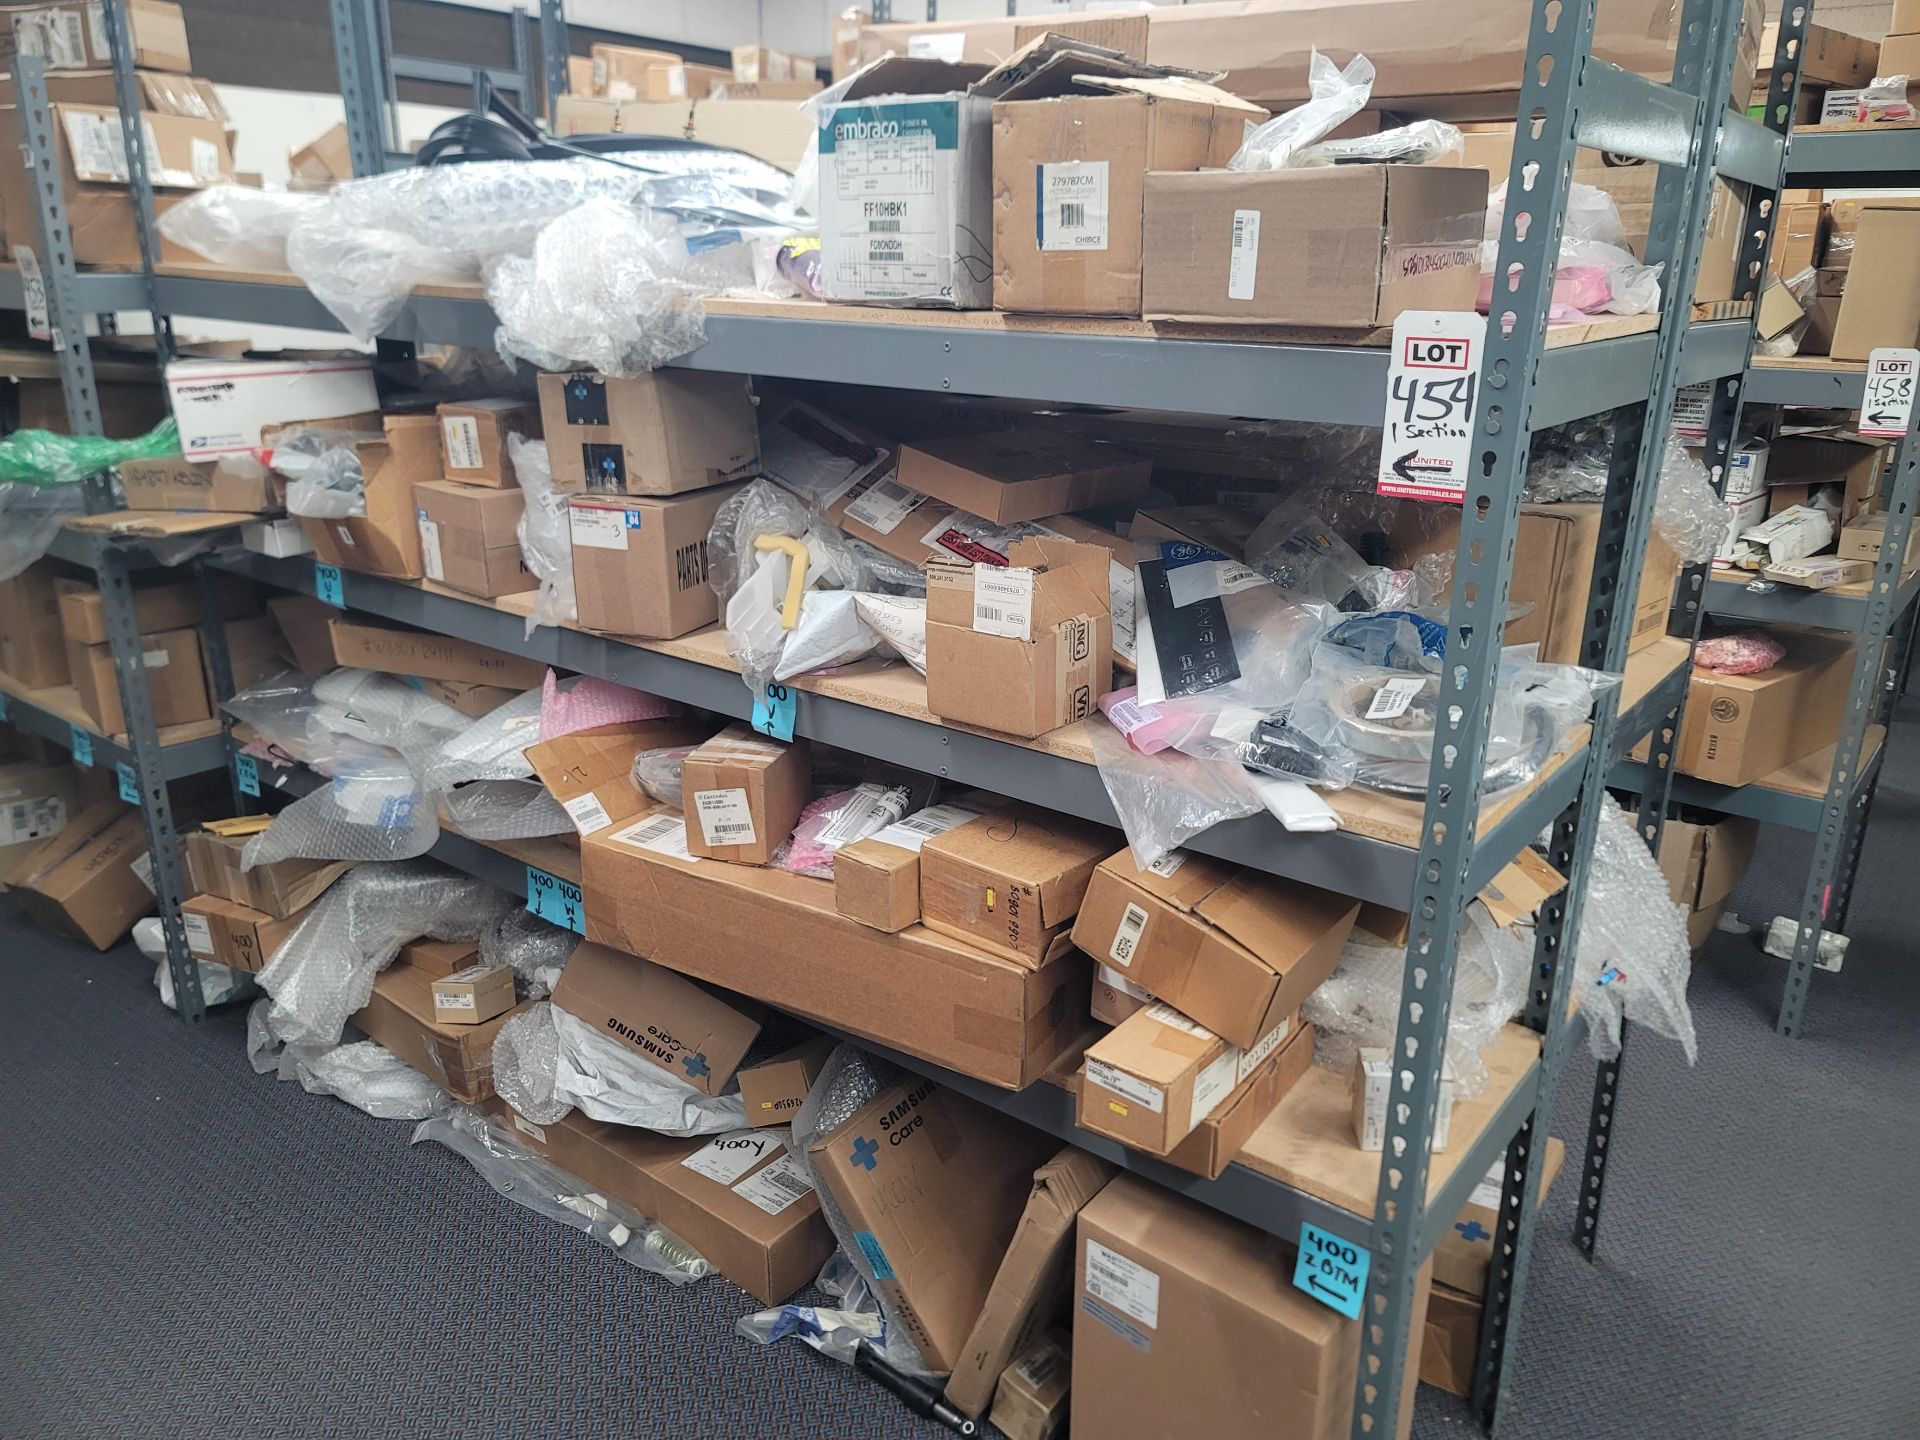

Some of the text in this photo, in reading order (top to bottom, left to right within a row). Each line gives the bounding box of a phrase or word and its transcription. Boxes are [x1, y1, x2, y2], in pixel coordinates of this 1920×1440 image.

[835, 118, 898, 140] embraco
[1052, 176, 1094, 186] 279787CM
[864, 202, 907, 217] FF10HBK1
[1412, 344, 1461, 363] LOT
[1880, 363, 1908, 371] LOT
[1392, 372, 1476, 423] 454
[1868, 377, 1911, 398] 458
[1406, 424, 1466, 438] Section
[1412, 457, 1453, 467] UNITED
[676, 543, 700, 592] PARTS
[768, 684, 787, 701] 00
[531, 871, 582, 903] 400 400
[565, 901, 574, 915] W
[231, 933, 252, 949] 400
[607, 1018, 675, 1063] SAMSUNG
[647, 1026, 681, 1051] Care
[879, 1079, 938, 1131] SAMSUN
[889, 1115, 924, 1146] Care
[1308, 1231, 1357, 1265] 400
[1321, 1258, 1359, 1294] BTM
